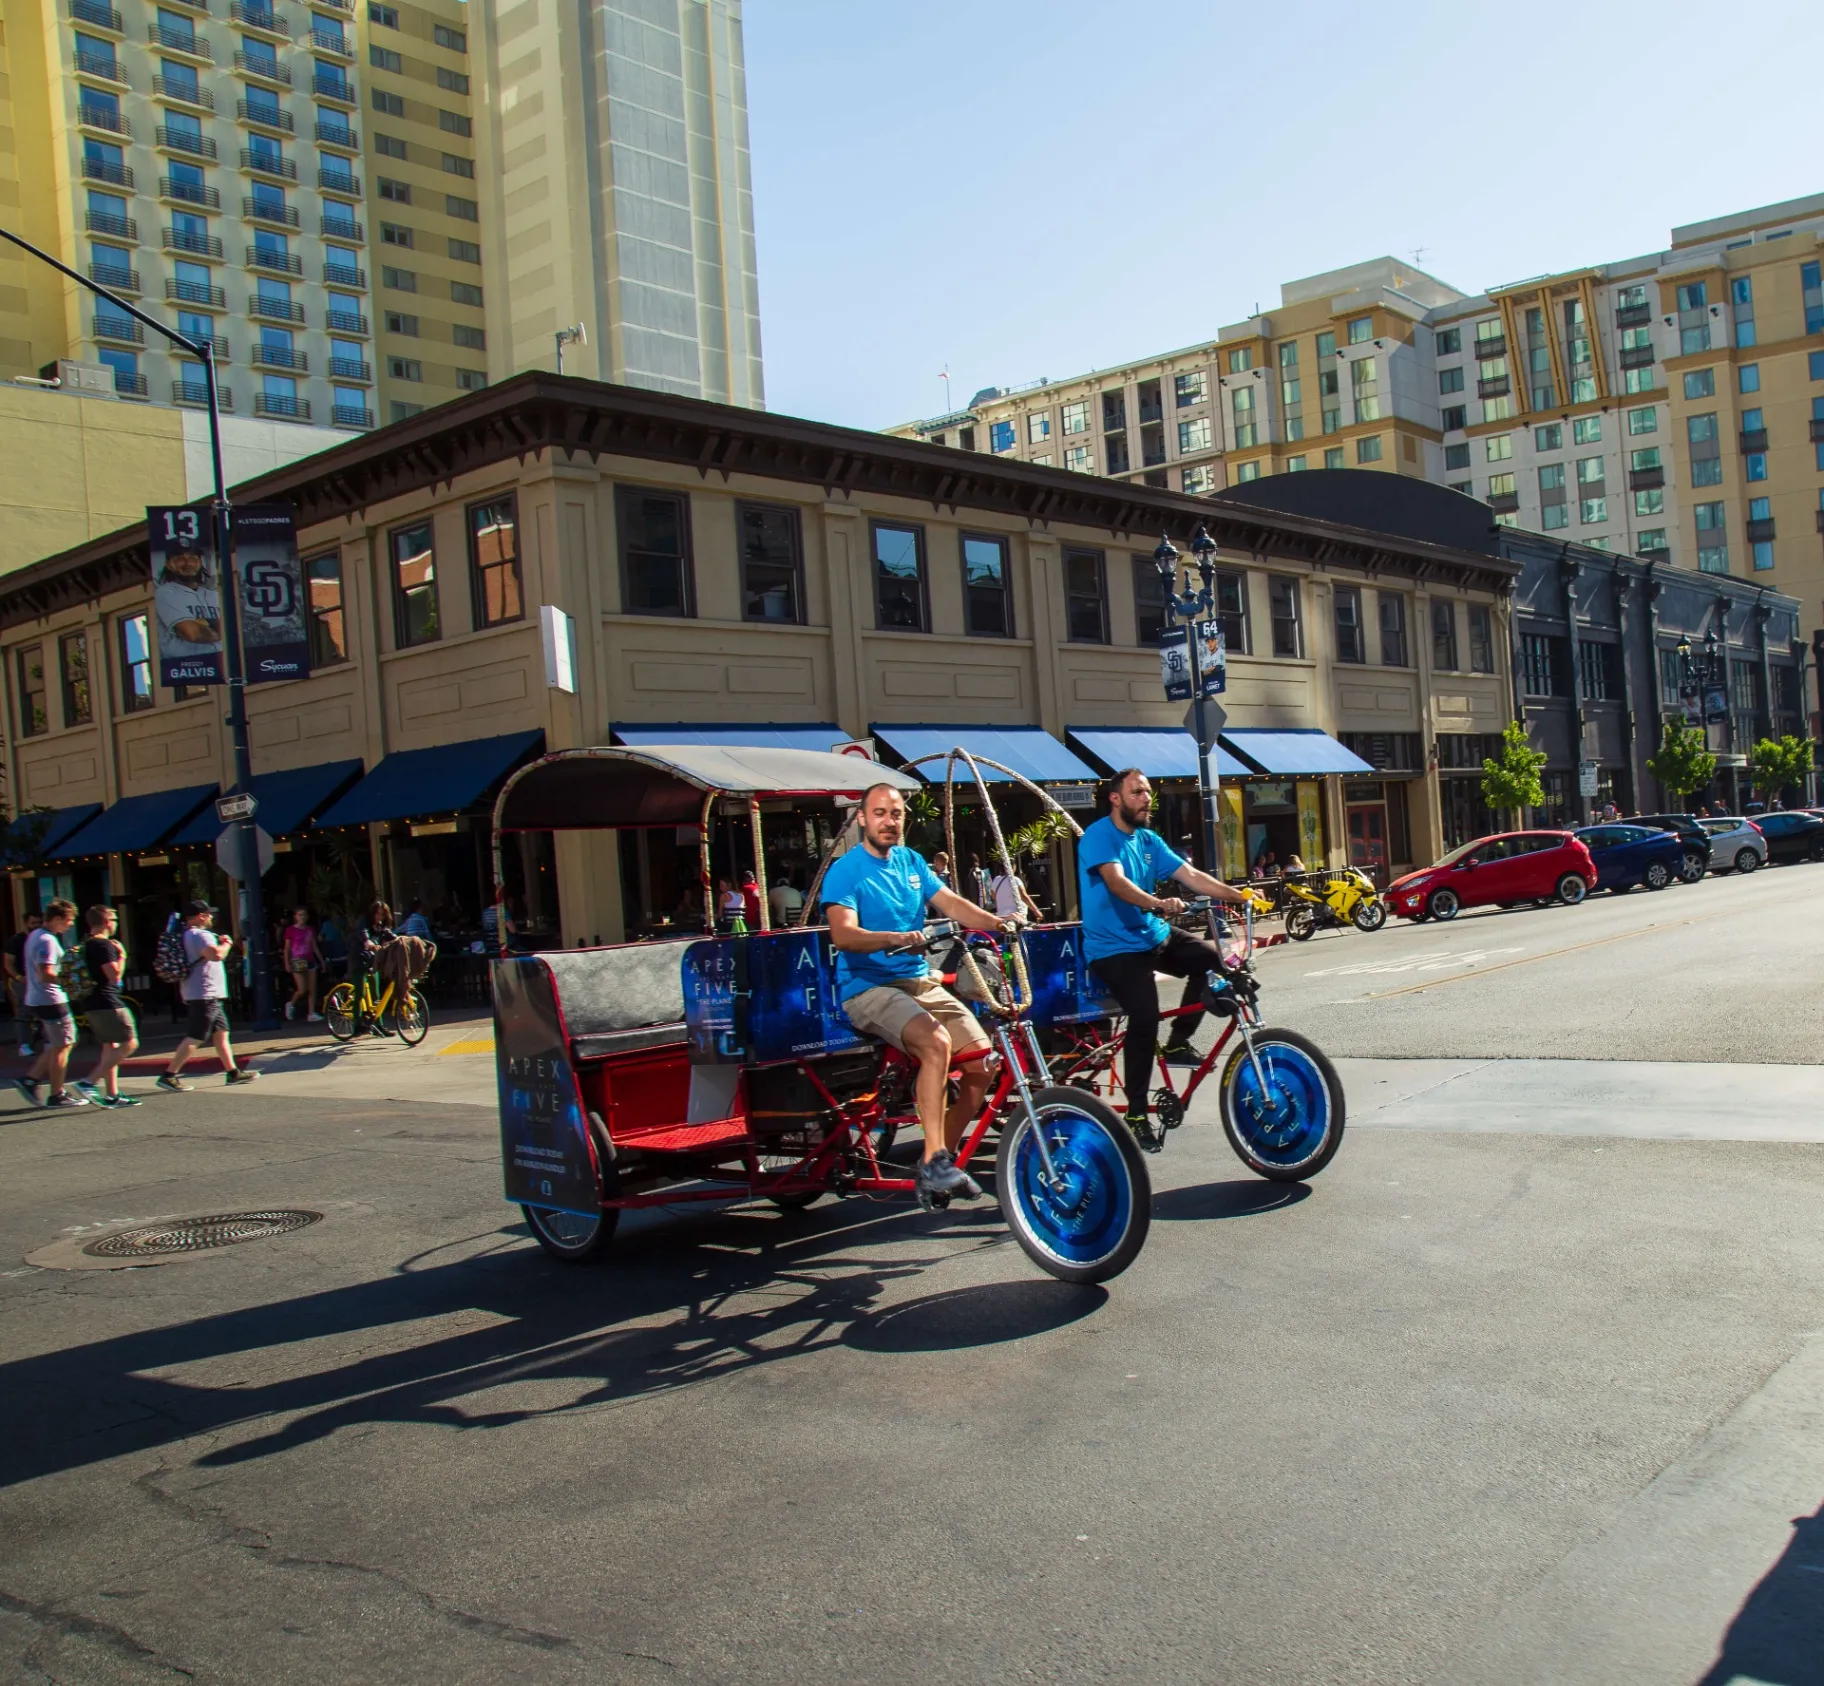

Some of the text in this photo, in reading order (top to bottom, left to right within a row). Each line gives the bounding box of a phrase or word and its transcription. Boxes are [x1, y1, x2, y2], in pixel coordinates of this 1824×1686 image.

[163, 511, 199, 540] 13
[1203, 620, 1218, 636] 64
[170, 667, 215, 679] GALVIS
[797, 944, 840, 970] AP
[694, 980, 738, 996] FIVE
[805, 985, 837, 1011] FI
[508, 1056, 560, 1079] APEX
[512, 1089, 560, 1113] FIVE
